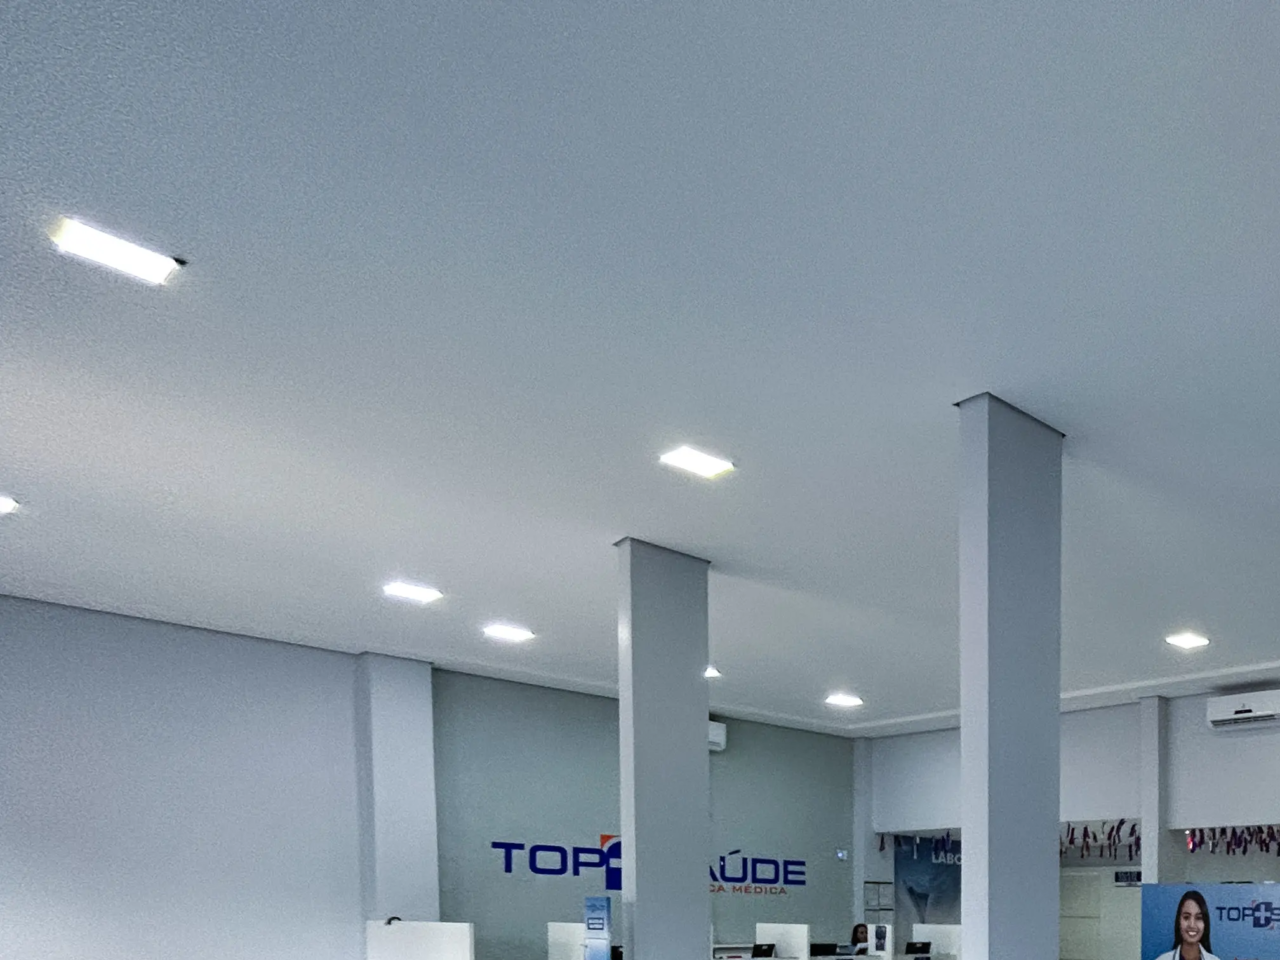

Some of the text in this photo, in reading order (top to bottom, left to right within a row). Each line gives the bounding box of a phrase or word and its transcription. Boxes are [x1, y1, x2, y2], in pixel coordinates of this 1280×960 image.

[491, 841, 607, 876] TOP
[732, 884, 787, 895] MÉDICA
[1216, 906, 1255, 921] TOP
